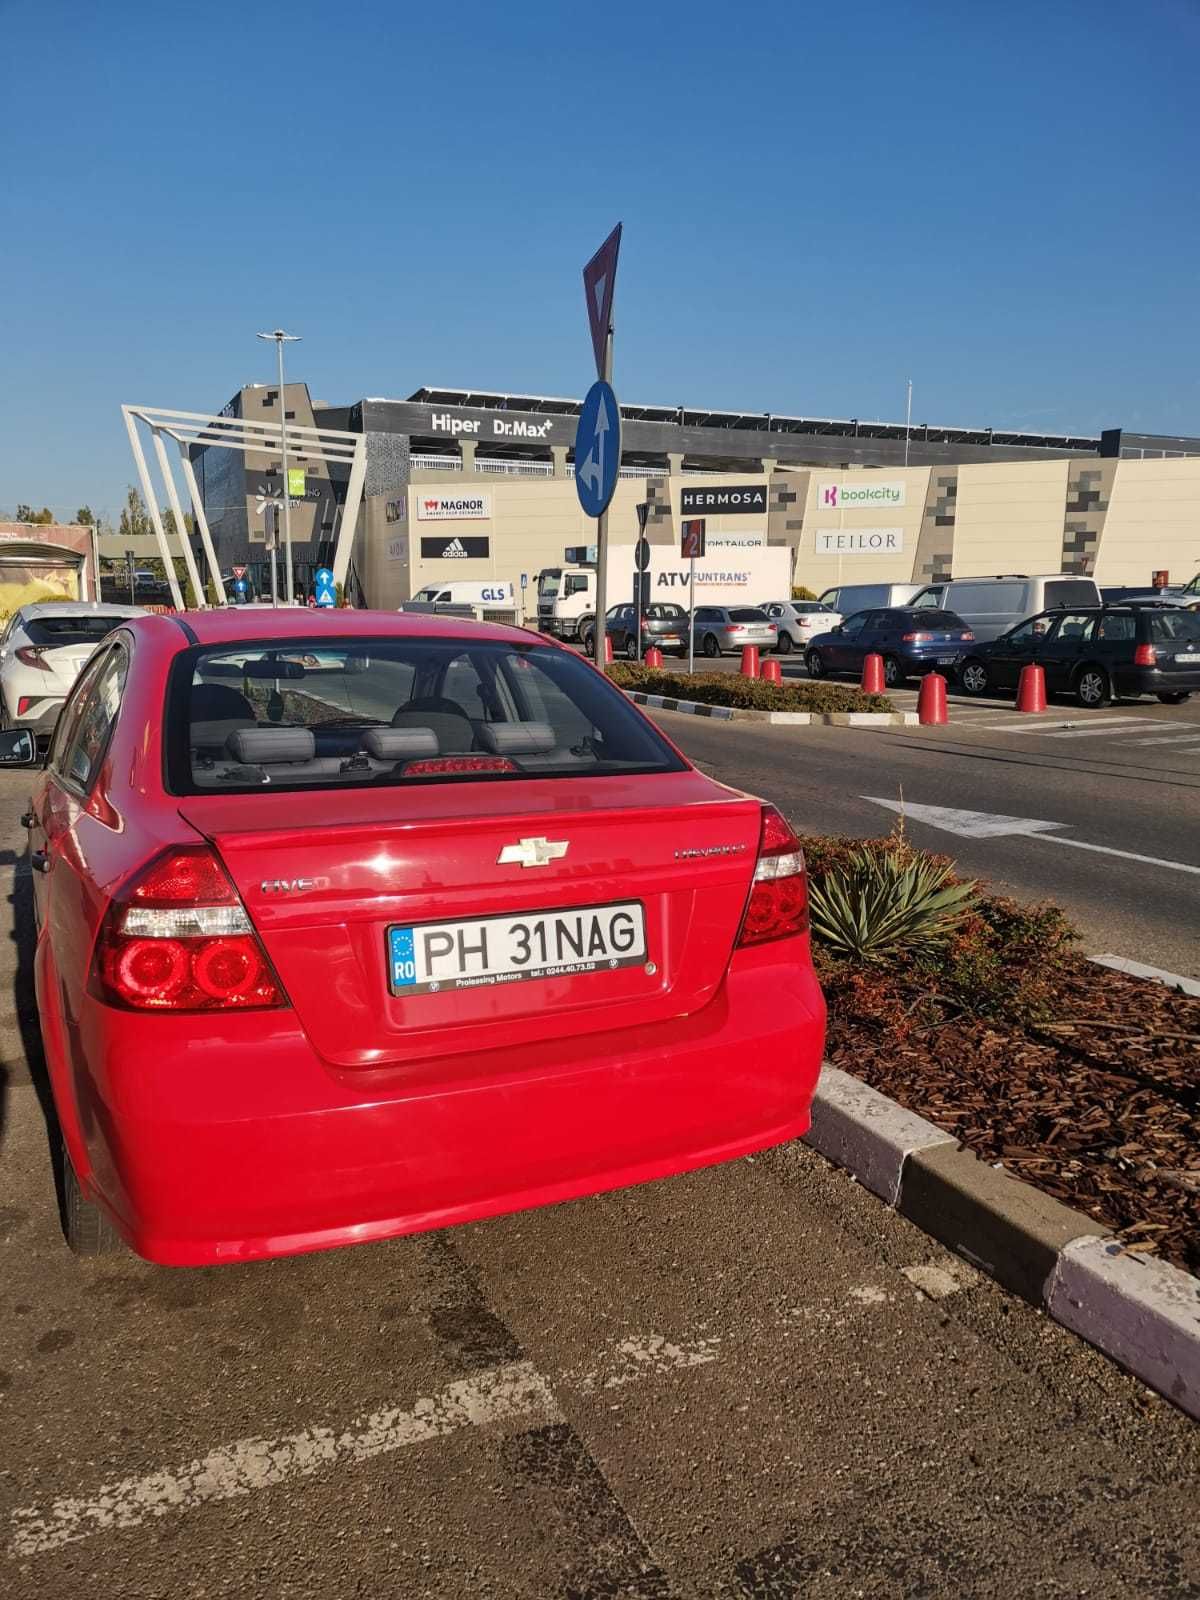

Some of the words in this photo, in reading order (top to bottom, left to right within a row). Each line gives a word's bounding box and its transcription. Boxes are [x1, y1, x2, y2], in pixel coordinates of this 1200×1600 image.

[431, 413, 481, 435] Hiper
[684, 492, 764, 505] HERMOSA
[841, 487, 900, 501] bookcity
[441, 500, 483, 511] MAGNOR
[688, 533, 698, 555] 2
[823, 534, 897, 549] TEILOR
[657, 572, 690, 586] ATV
[481, 588, 505, 601] GLS
[423, 926, 489, 976] PH
[394, 961, 415, 980] RO
[496, 973, 522, 983] Motors
